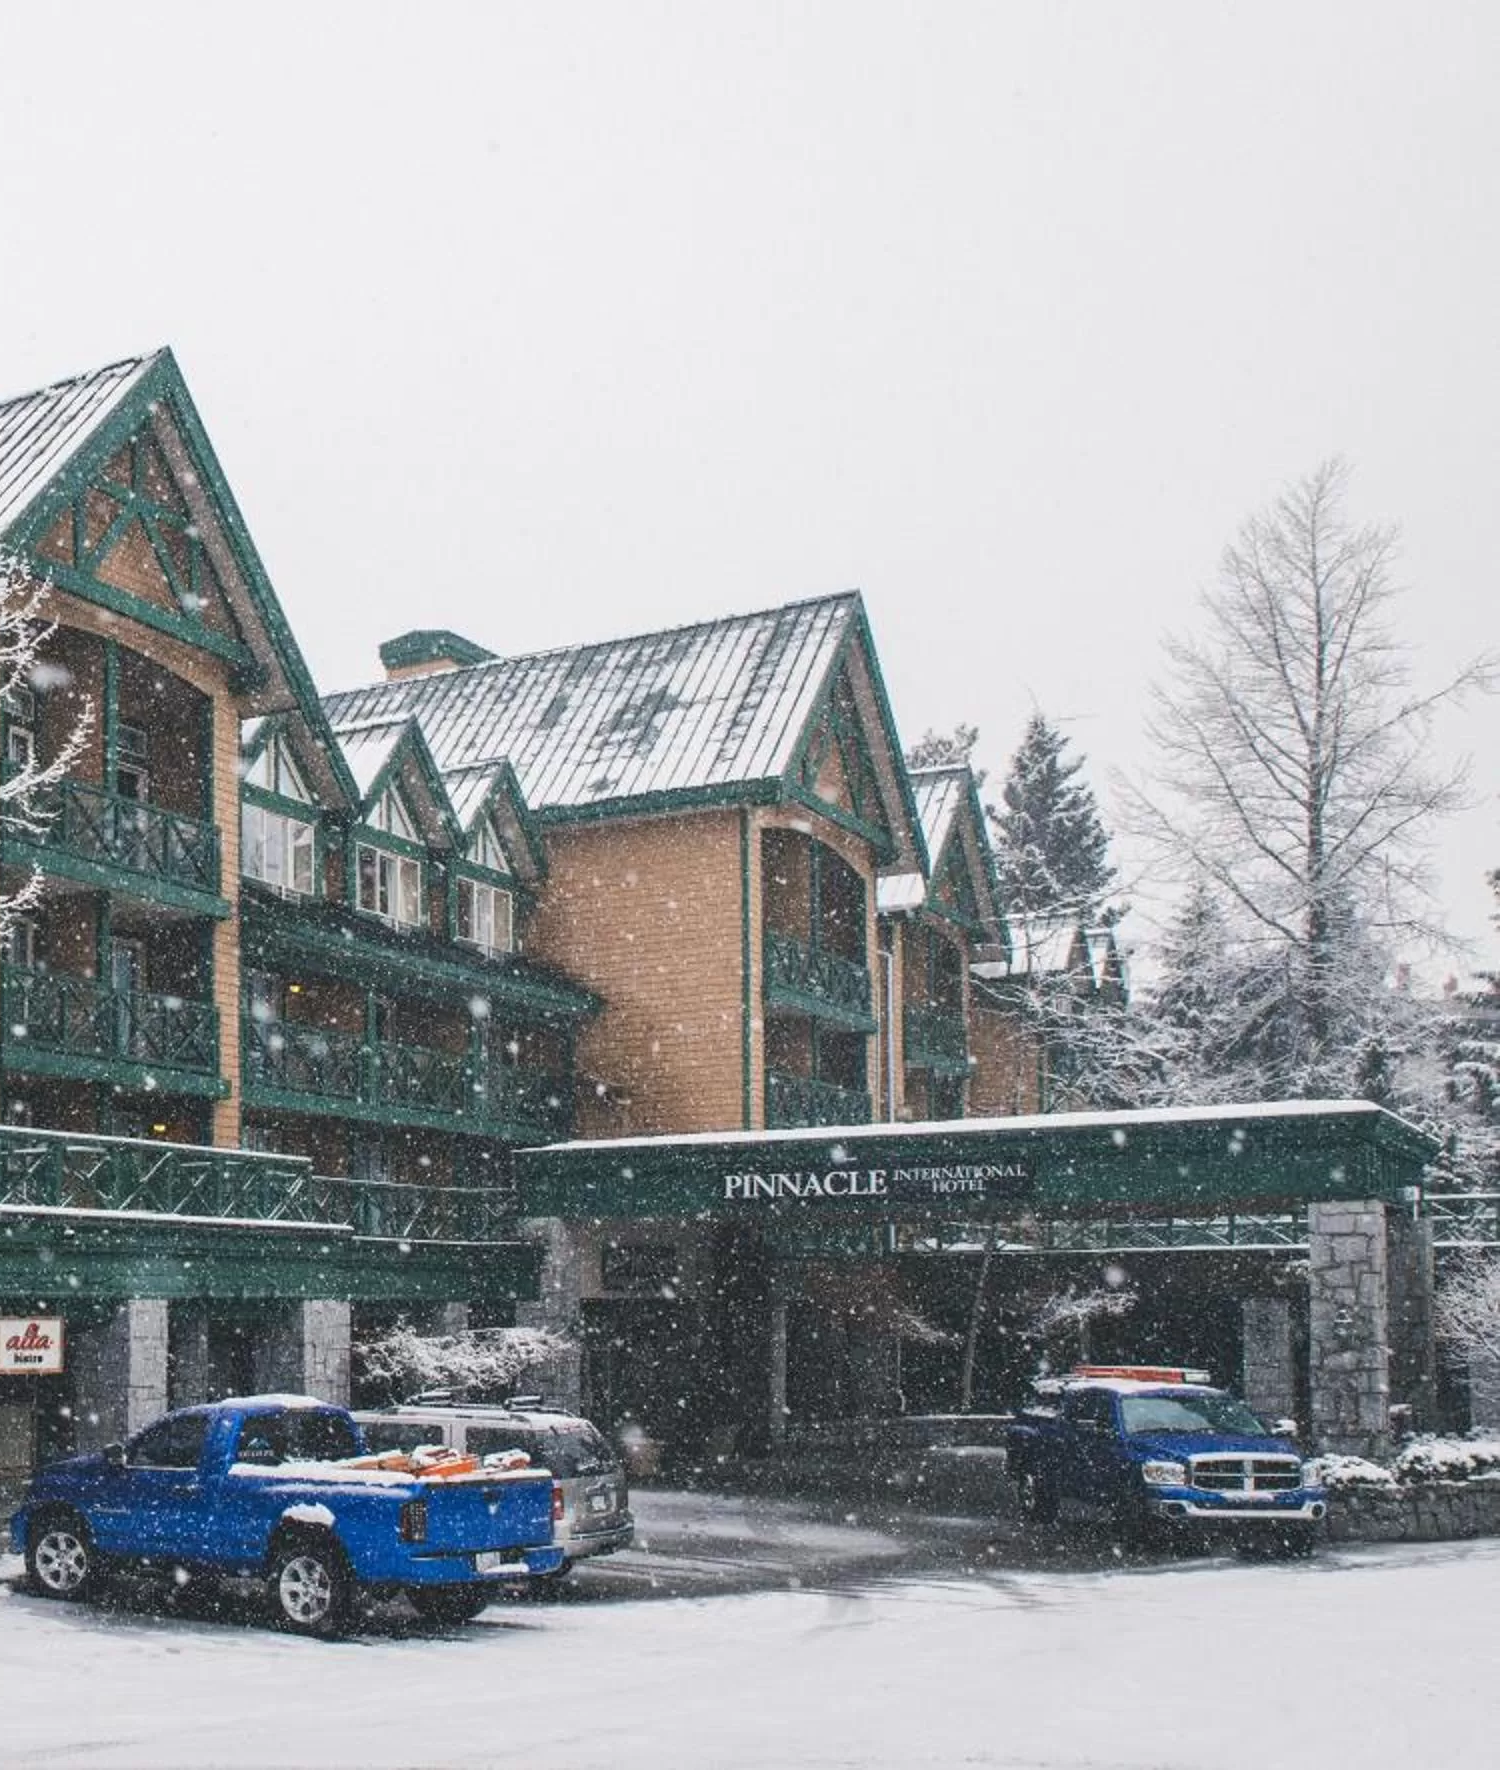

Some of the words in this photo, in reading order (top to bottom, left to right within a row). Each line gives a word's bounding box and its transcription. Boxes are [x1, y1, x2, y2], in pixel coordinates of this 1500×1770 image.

[724, 1170, 887, 1198] PINNACLE
[893, 1164, 1028, 1180] INTERNATIONAL
[933, 1180, 986, 1193] HOTEL
[5, 1323, 51, 1350] alta
